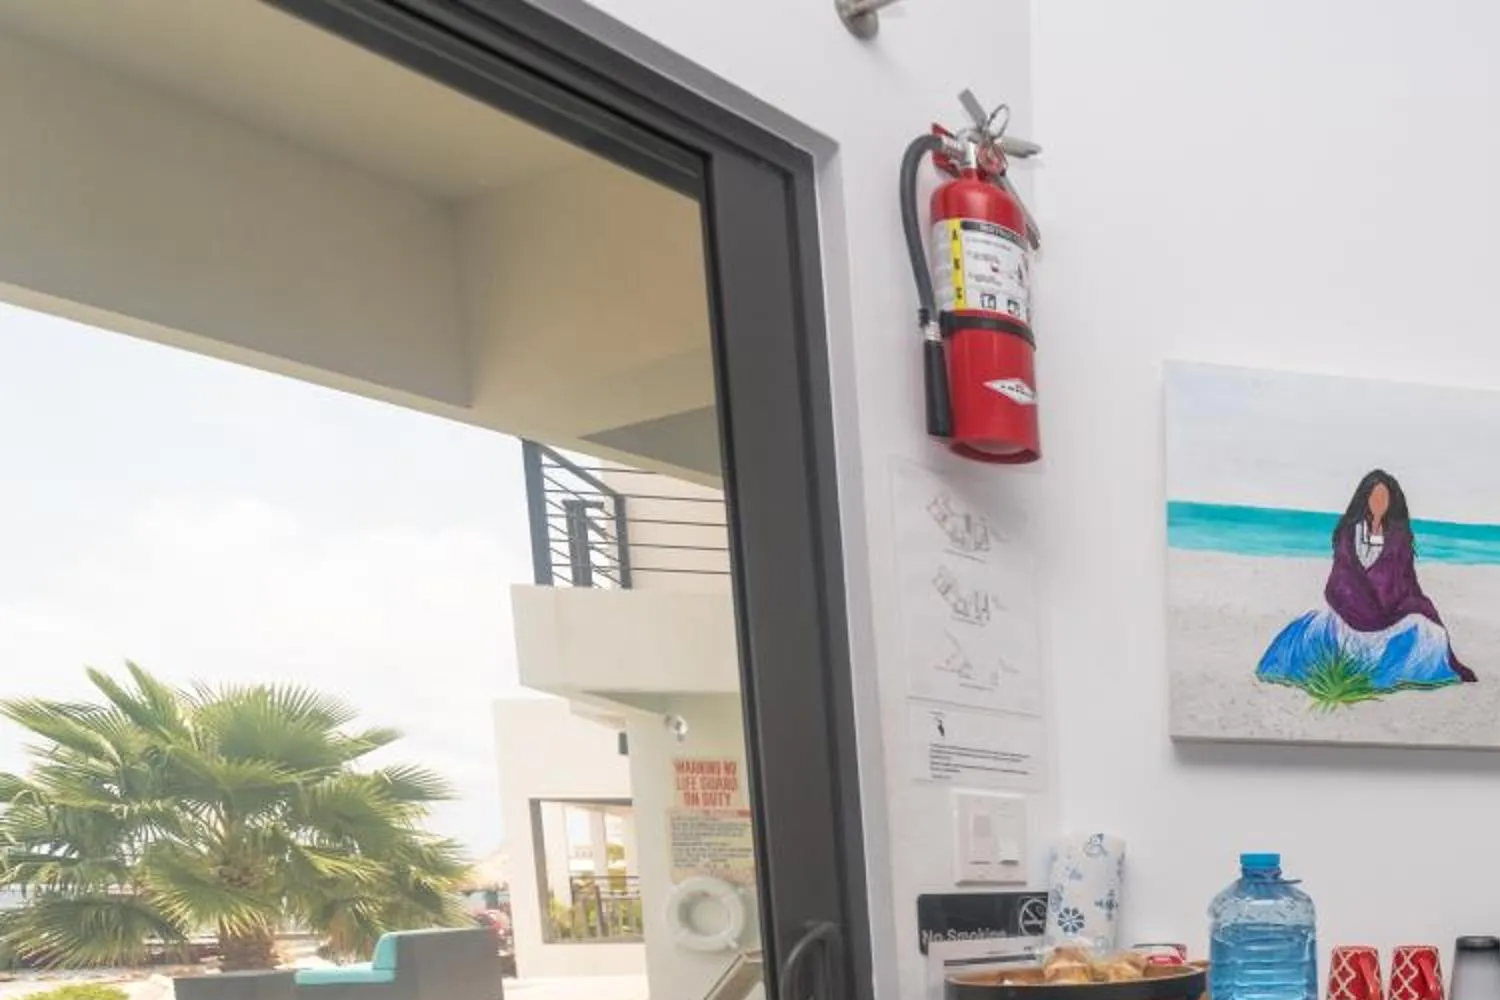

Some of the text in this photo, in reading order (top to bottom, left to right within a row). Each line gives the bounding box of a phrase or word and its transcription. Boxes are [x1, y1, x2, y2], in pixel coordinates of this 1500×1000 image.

[677, 776, 697, 790] LIFE
[702, 792, 730, 806] DUTY
[922, 929, 943, 945] No
